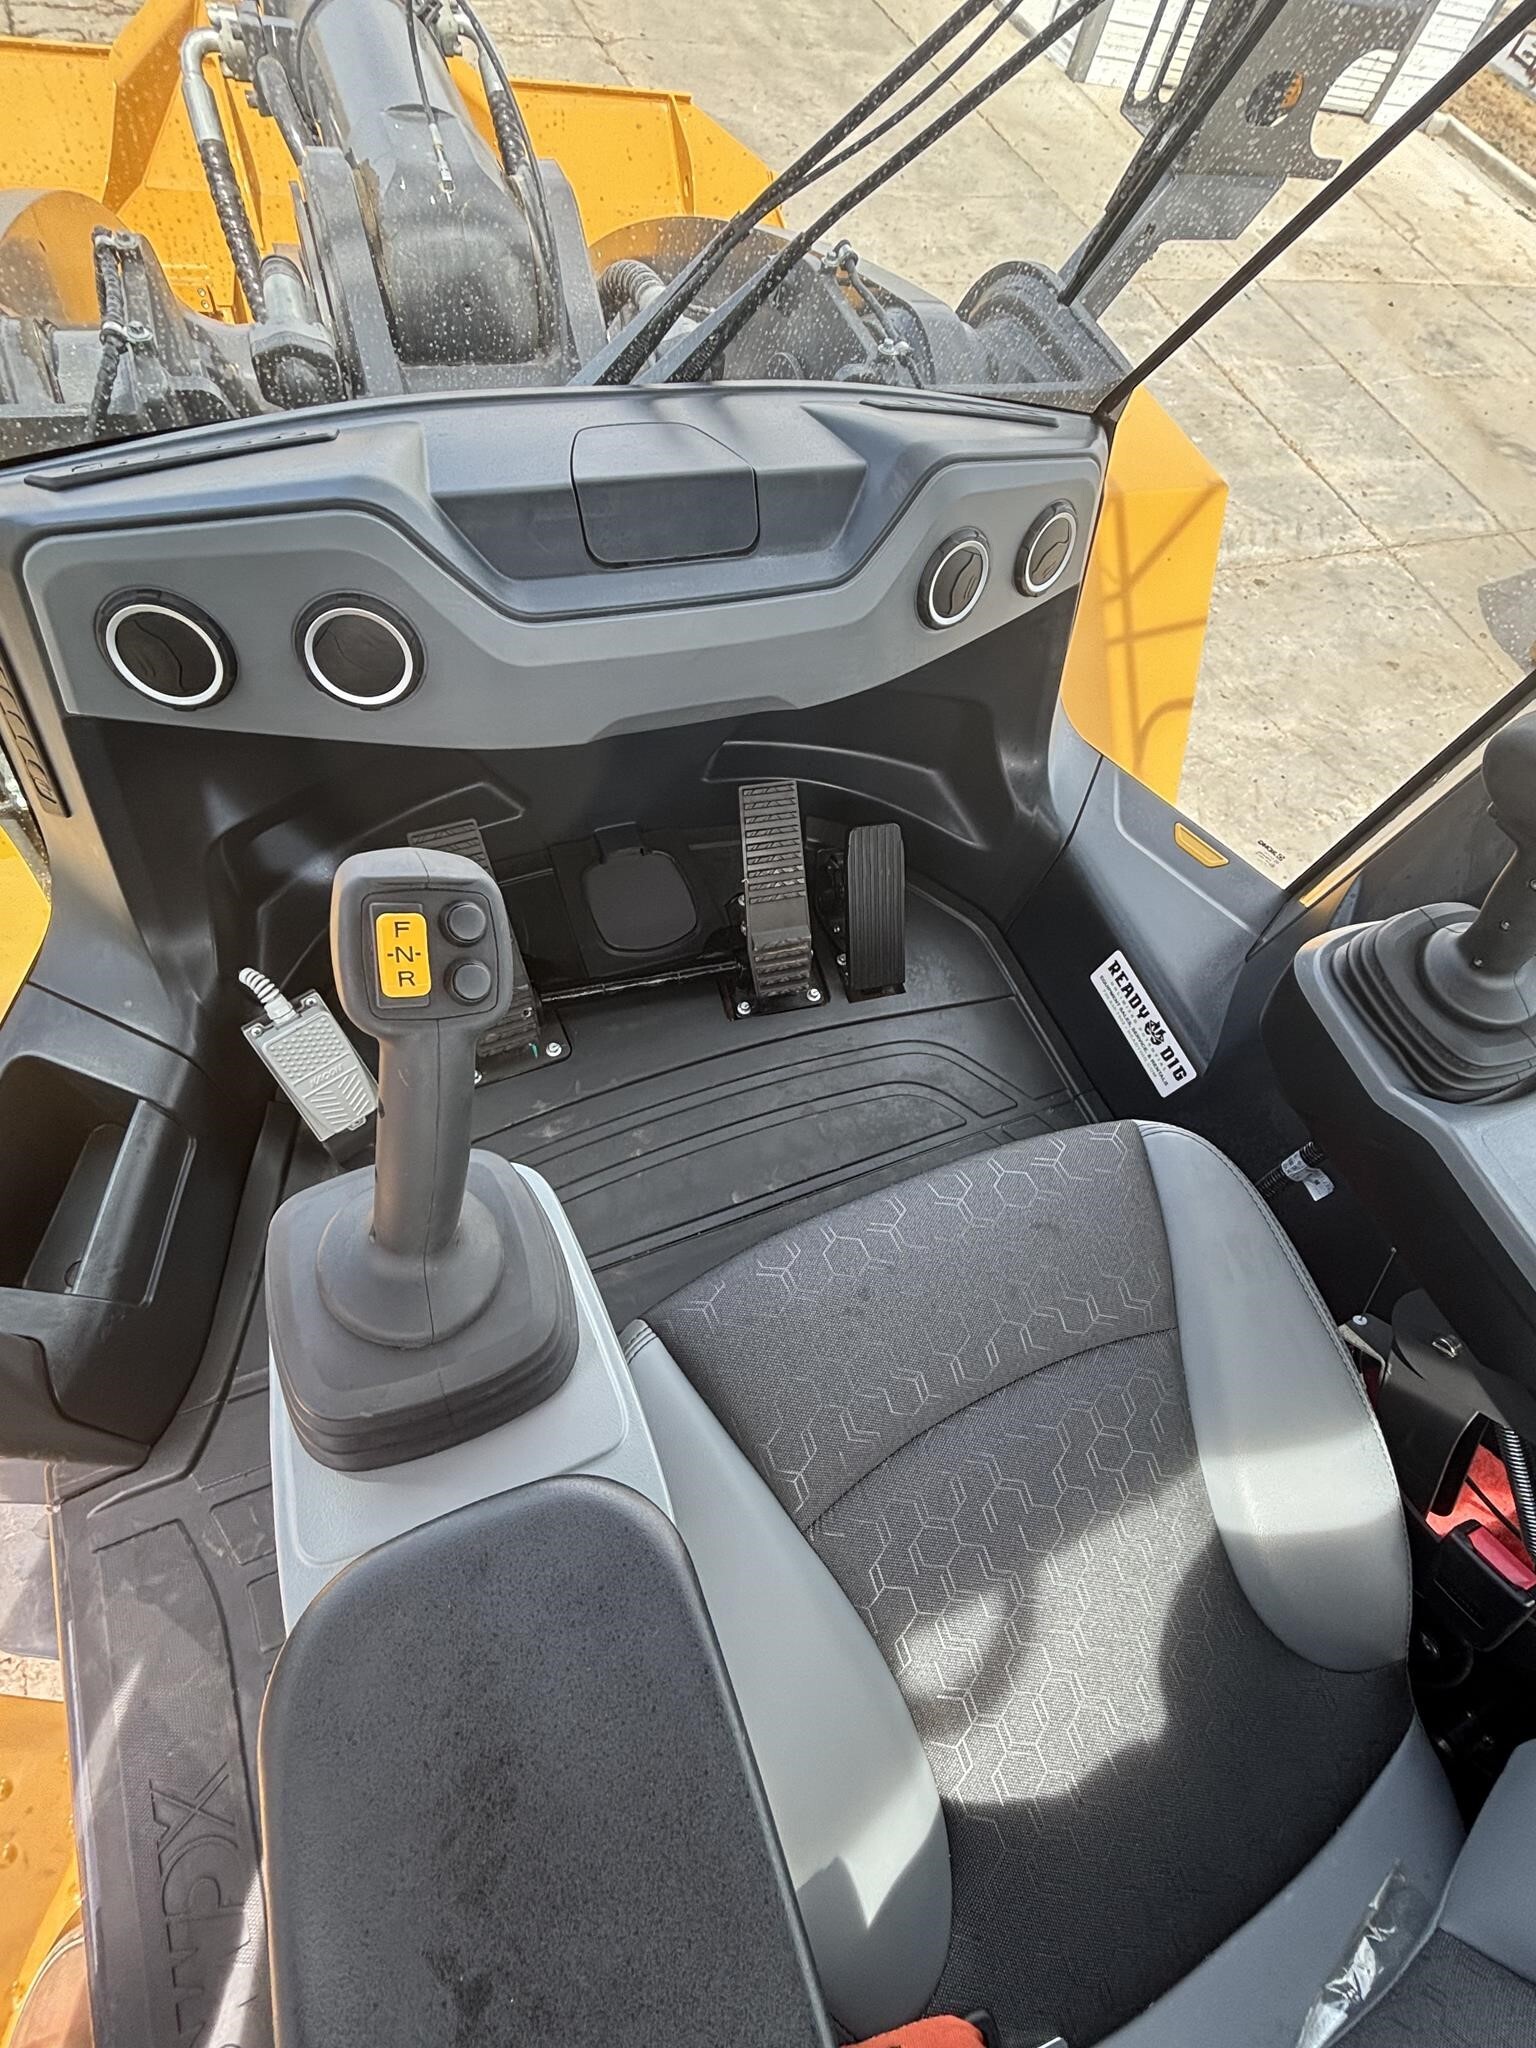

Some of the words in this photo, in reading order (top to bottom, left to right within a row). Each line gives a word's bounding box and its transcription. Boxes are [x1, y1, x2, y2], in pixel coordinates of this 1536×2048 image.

[394, 921, 411, 938] F
[397, 970, 415, 988] R
[1107, 960, 1150, 1020] READY
[1160, 1045, 1188, 1082] DIG
